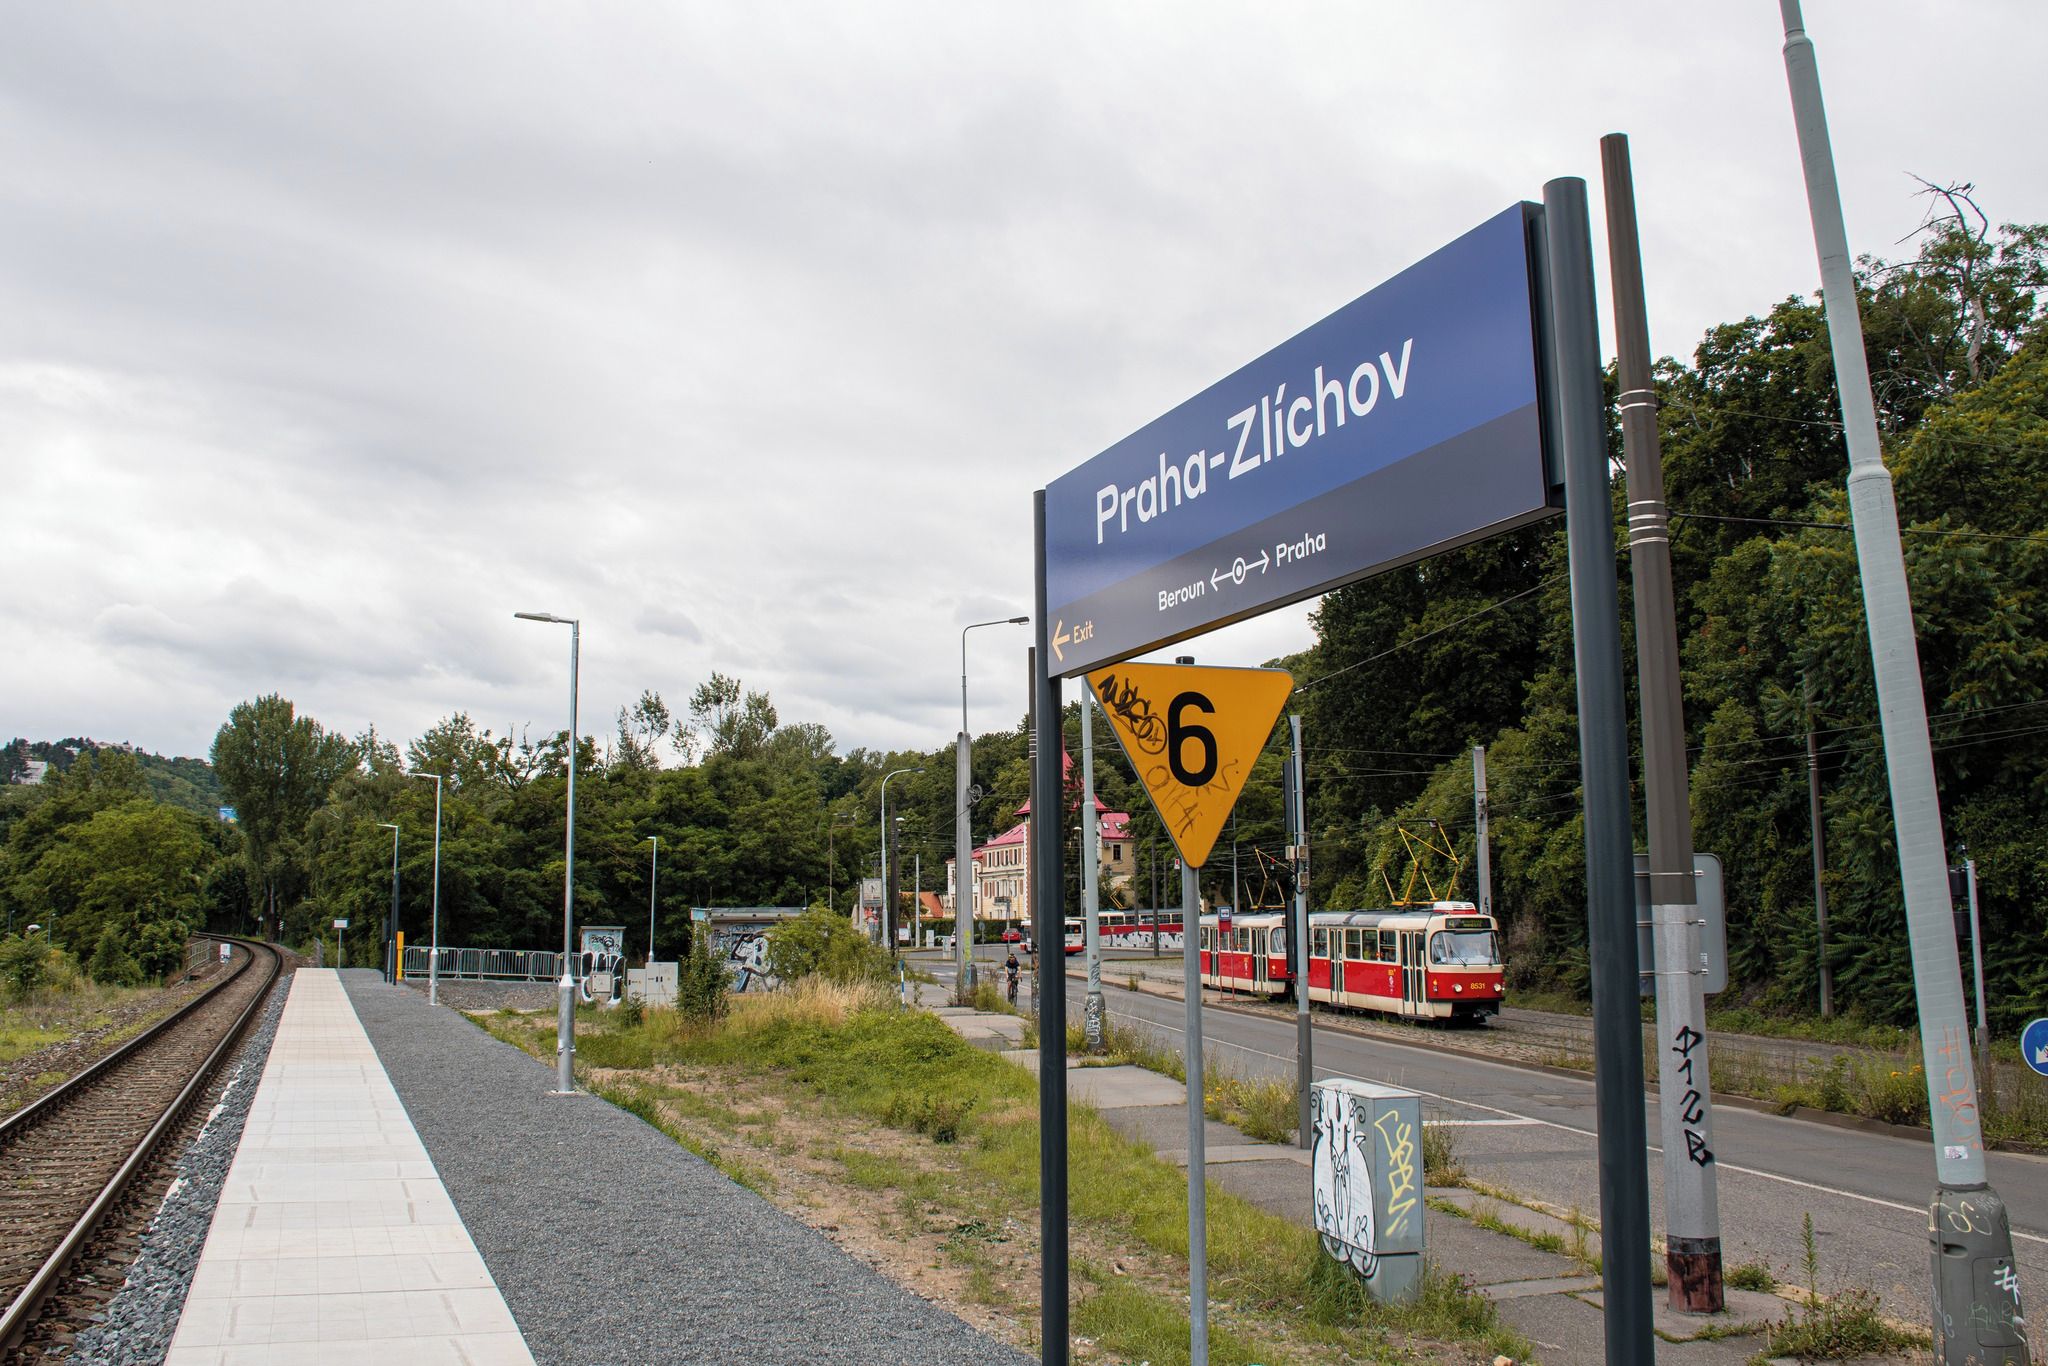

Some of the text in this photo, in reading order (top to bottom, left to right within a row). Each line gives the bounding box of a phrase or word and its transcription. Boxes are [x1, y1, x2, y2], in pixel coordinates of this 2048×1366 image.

[1096, 338, 1413, 545] Praha-Zlíchov
[1158, 533, 1326, 611] Beroun Praha
[1073, 621, 1094, 644] Exit
[1168, 691, 1218, 787] 6
[1470, 982, 1486, 990] 8531
